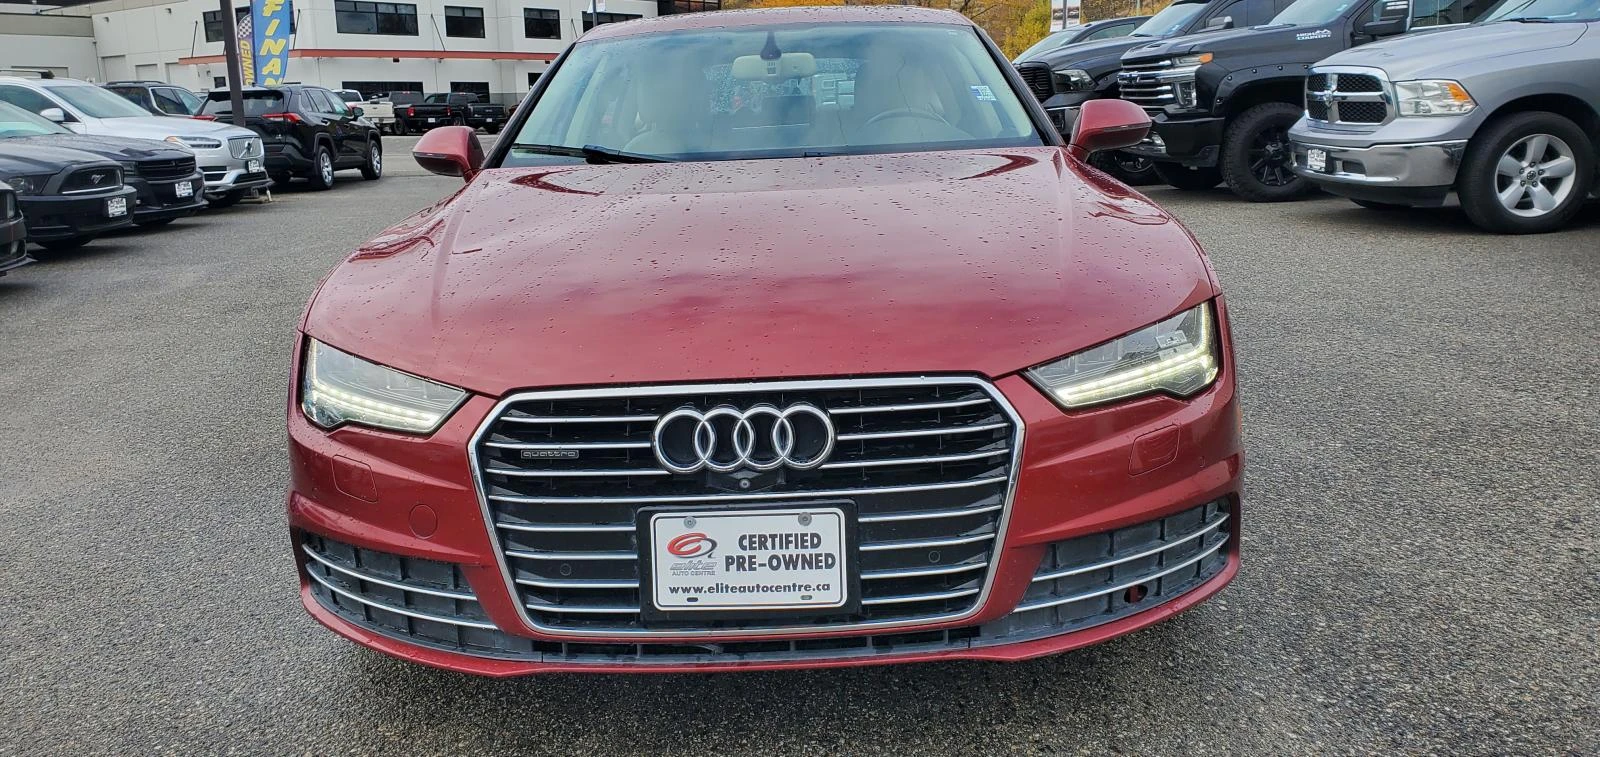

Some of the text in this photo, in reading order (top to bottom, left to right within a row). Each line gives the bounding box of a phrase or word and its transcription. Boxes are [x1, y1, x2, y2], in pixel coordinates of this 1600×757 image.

[738, 532, 822, 551] CERTIFIED
[724, 552, 836, 572] PRE-OWNED
[668, 582, 831, 594] www.eliteautocentre.ca
